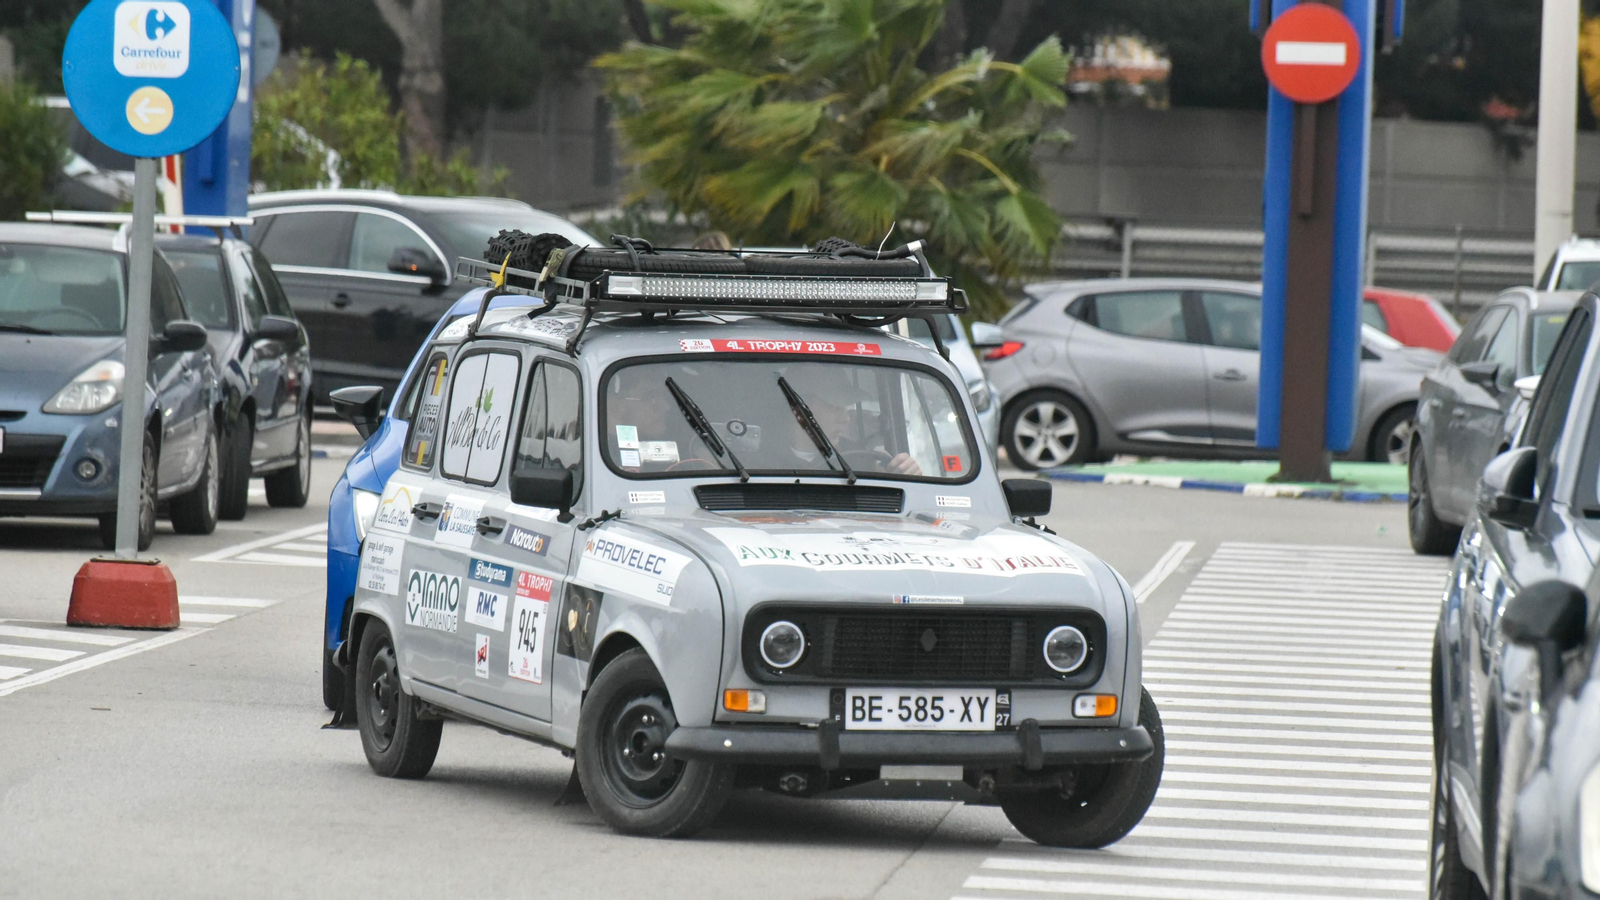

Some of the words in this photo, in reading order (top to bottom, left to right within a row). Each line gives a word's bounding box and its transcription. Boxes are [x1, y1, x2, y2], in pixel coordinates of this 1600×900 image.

[121, 46, 182, 60] Carrefour
[726, 340, 744, 351] 4L
[747, 341, 802, 352] TROPHY
[807, 342, 836, 352] 2023
[418, 416, 437, 434] AUTO
[946, 458, 957, 469] F
[453, 506, 480, 522] COMMUNE
[448, 522, 456, 532] LA
[455, 523, 477, 536] SAUSSAYE
[510, 528, 544, 553] Norauto
[593, 538, 667, 575] PROVELEC
[736, 545, 796, 561] AUX
[801, 552, 956, 568] GOURMETS
[474, 560, 507, 583] Studyrama
[518, 572, 526, 587] 4L
[527, 574, 554, 593] TROPHY
[656, 583, 674, 596] SUD
[476, 591, 498, 618] RMC
[420, 610, 457, 633] NORMANDIE
[517, 608, 539, 654] 945
[834, 714, 841, 722] F
[851, 695, 990, 723] BE-585-XY
[995, 713, 1010, 727] 27
